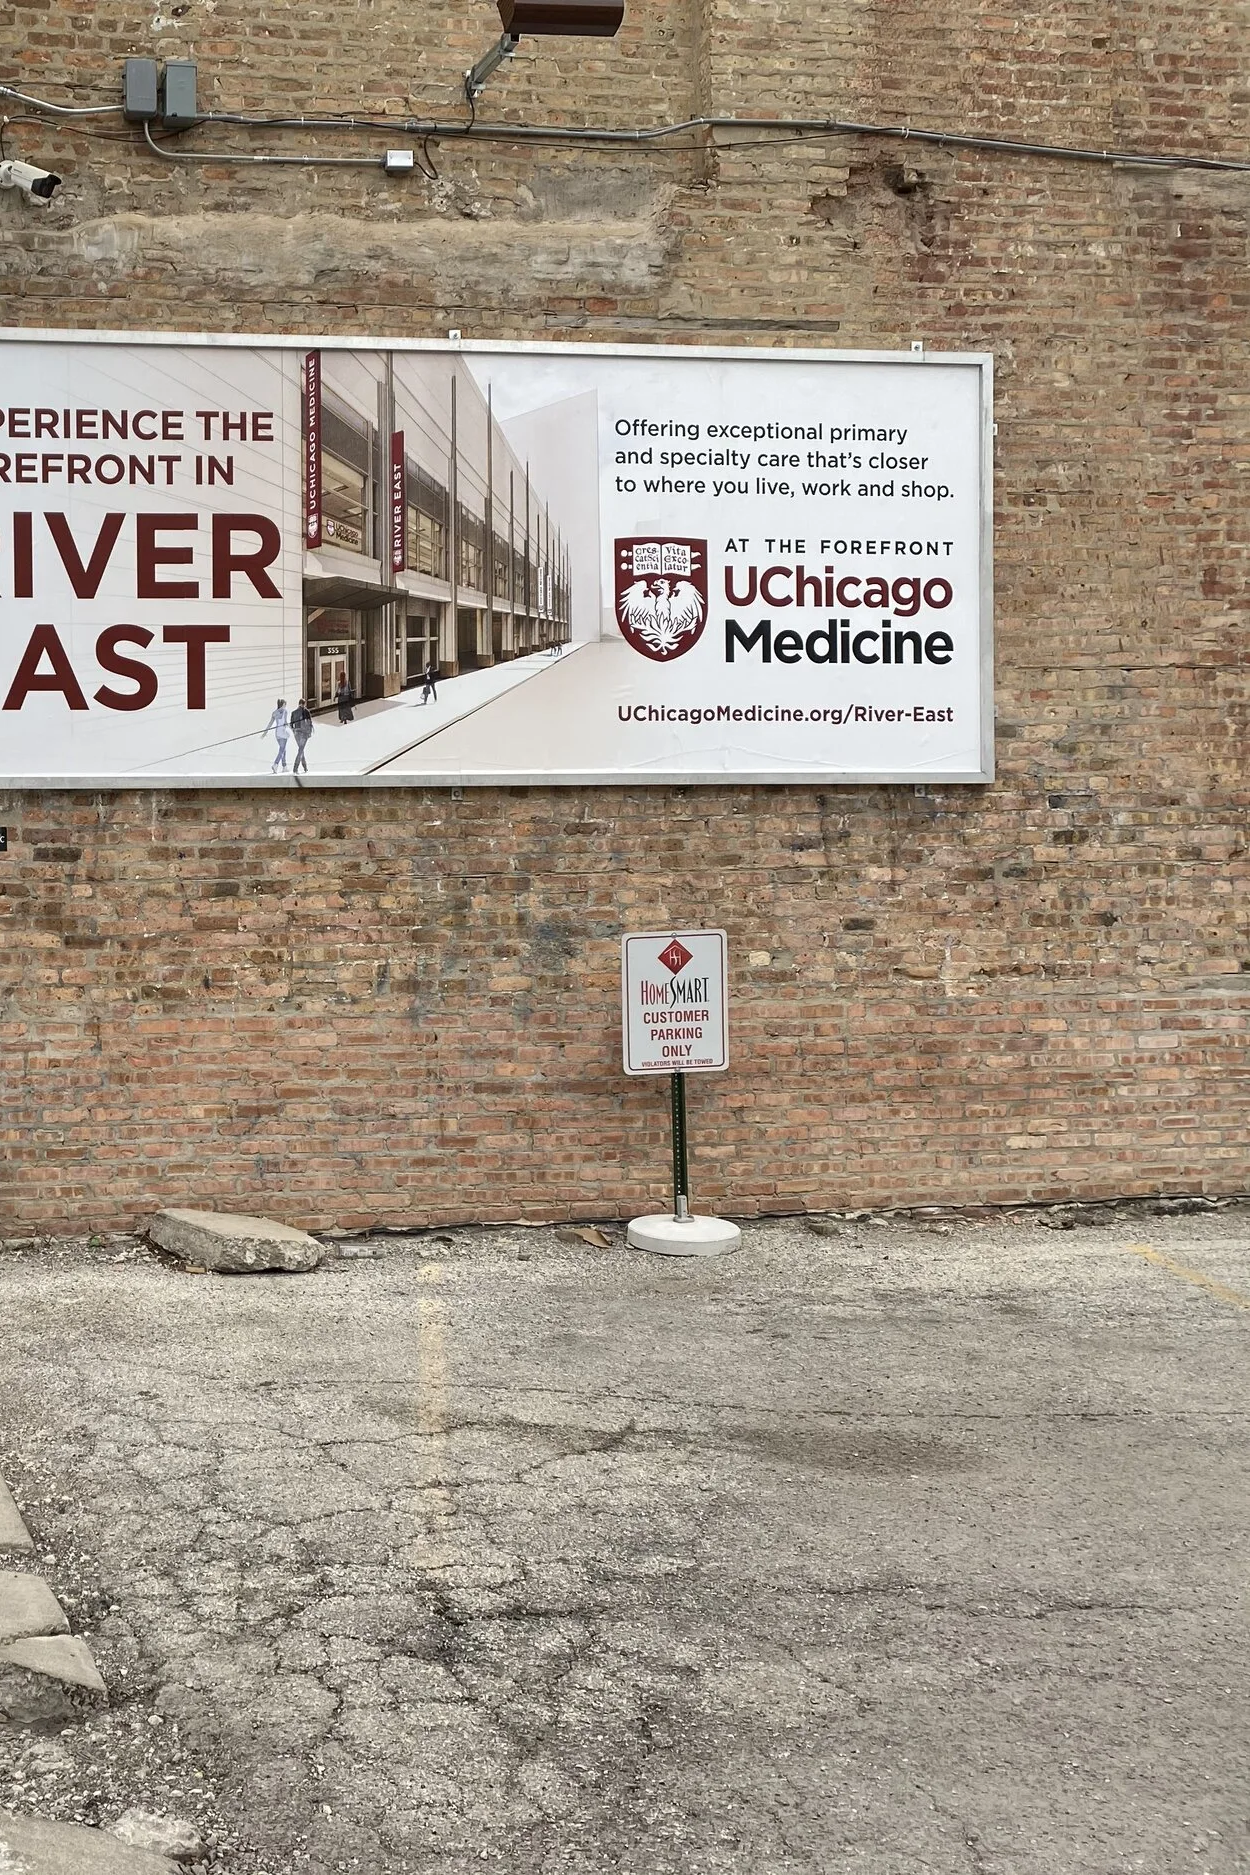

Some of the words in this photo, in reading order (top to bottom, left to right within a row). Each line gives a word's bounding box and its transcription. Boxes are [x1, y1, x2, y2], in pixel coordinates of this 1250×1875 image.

[308, 358, 316, 429] MEDICINE
[196, 411, 274, 441] THE
[615, 418, 699, 441] Offering
[707, 421, 823, 442] exceptional
[830, 425, 908, 446] primary
[195, 455, 234, 486] IN
[308, 431, 317, 510] UCHICAGO
[615, 447, 653, 465] and
[660, 448, 751, 470] specialty
[757, 453, 801, 468] care
[806, 450, 862, 468] that's
[868, 451, 929, 470] closer
[393, 463, 402, 500] EAST
[615, 476, 637, 493] to
[643, 475, 706, 494] where
[712, 480, 749, 498] you
[756, 477, 795, 499] live,
[802, 479, 852, 497] work
[857, 479, 895, 497] and
[901, 480, 954, 502] shop.
[393, 501, 402, 548] RIVER
[725, 538, 750, 553] AT
[764, 539, 806, 554] THE
[821, 540, 954, 556] FOREFRONT
[724, 565, 954, 618] UChicago
[725, 619, 954, 665] Medicine
[619, 704, 954, 725] UChicagoMedicine.org/River-East
[643, 1010, 709, 1024] CUSTOMER
[651, 1027, 703, 1041] PARKING
[641, 1060, 671, 1068] VIOLATORS
[662, 1045, 693, 1057] ONLY
